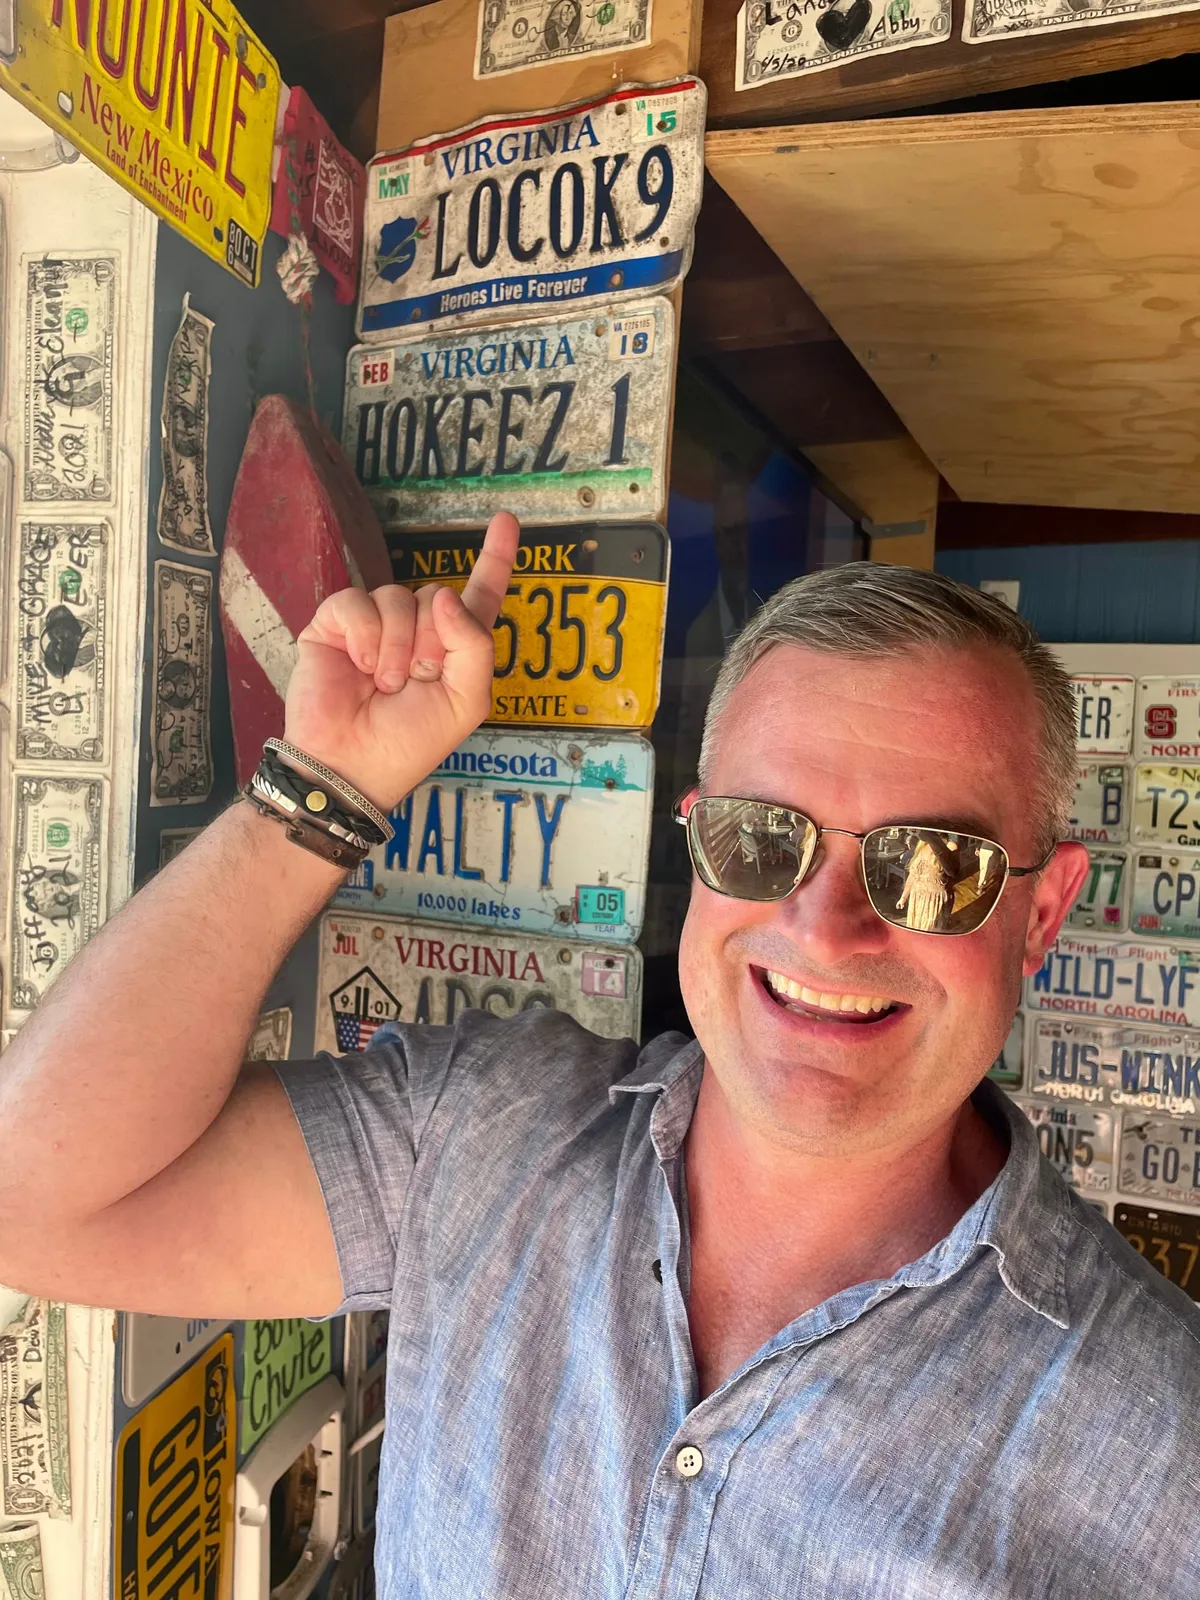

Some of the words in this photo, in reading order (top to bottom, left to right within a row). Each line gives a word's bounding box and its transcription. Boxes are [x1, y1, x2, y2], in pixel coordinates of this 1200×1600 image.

[869, 10, 920, 41] Abby
[1043, 14, 1074, 26] ONE
[1077, 4, 1138, 22] DOLLAR
[550, 44, 593, 59] DOLLAR
[833, 41, 884, 60] DOLLAR
[646, 110, 677, 136] 15
[80, 72, 136, 152] New
[138, 128, 214, 222] Mexico
[441, 115, 600, 180] VIRGINIA
[106, 140, 126, 170] Land
[128, 163, 138, 179] of
[139, 169, 188, 225] Enchantment
[379, 173, 410, 199] MAY
[234, 227, 257, 270] OCT
[440, 287, 487, 313] Heroes
[491, 282, 523, 302] Live
[527, 275, 588, 298] Forever
[104, 334, 112, 390] DOLLAR
[421, 335, 576, 379] VIRGINIA
[363, 362, 388, 385] FEB
[356, 381, 576, 487] HOKEEZ
[412, 549, 480, 577] NEW
[517, 543, 577, 572] ORK
[97, 598, 105, 658] DOLLAR
[495, 695, 568, 717] STATE
[438, 751, 558, 778] nnesota
[417, 892, 467, 914] 10,000
[471, 898, 521, 921] lakes
[597, 893, 618, 911] 05
[1153, 871, 1200, 918] CP
[594, 925, 616, 934] YEAR
[333, 935, 359, 956] JUL
[394, 936, 546, 983] VIRGINIA
[1129, 947, 1168, 961] Flight
[1040, 997, 1097, 1014] NORTH
[1104, 1004, 1189, 1025] CAROLINA
[250, 1328, 325, 1431] Chute
[203, 1438, 227, 1577] IOWA
